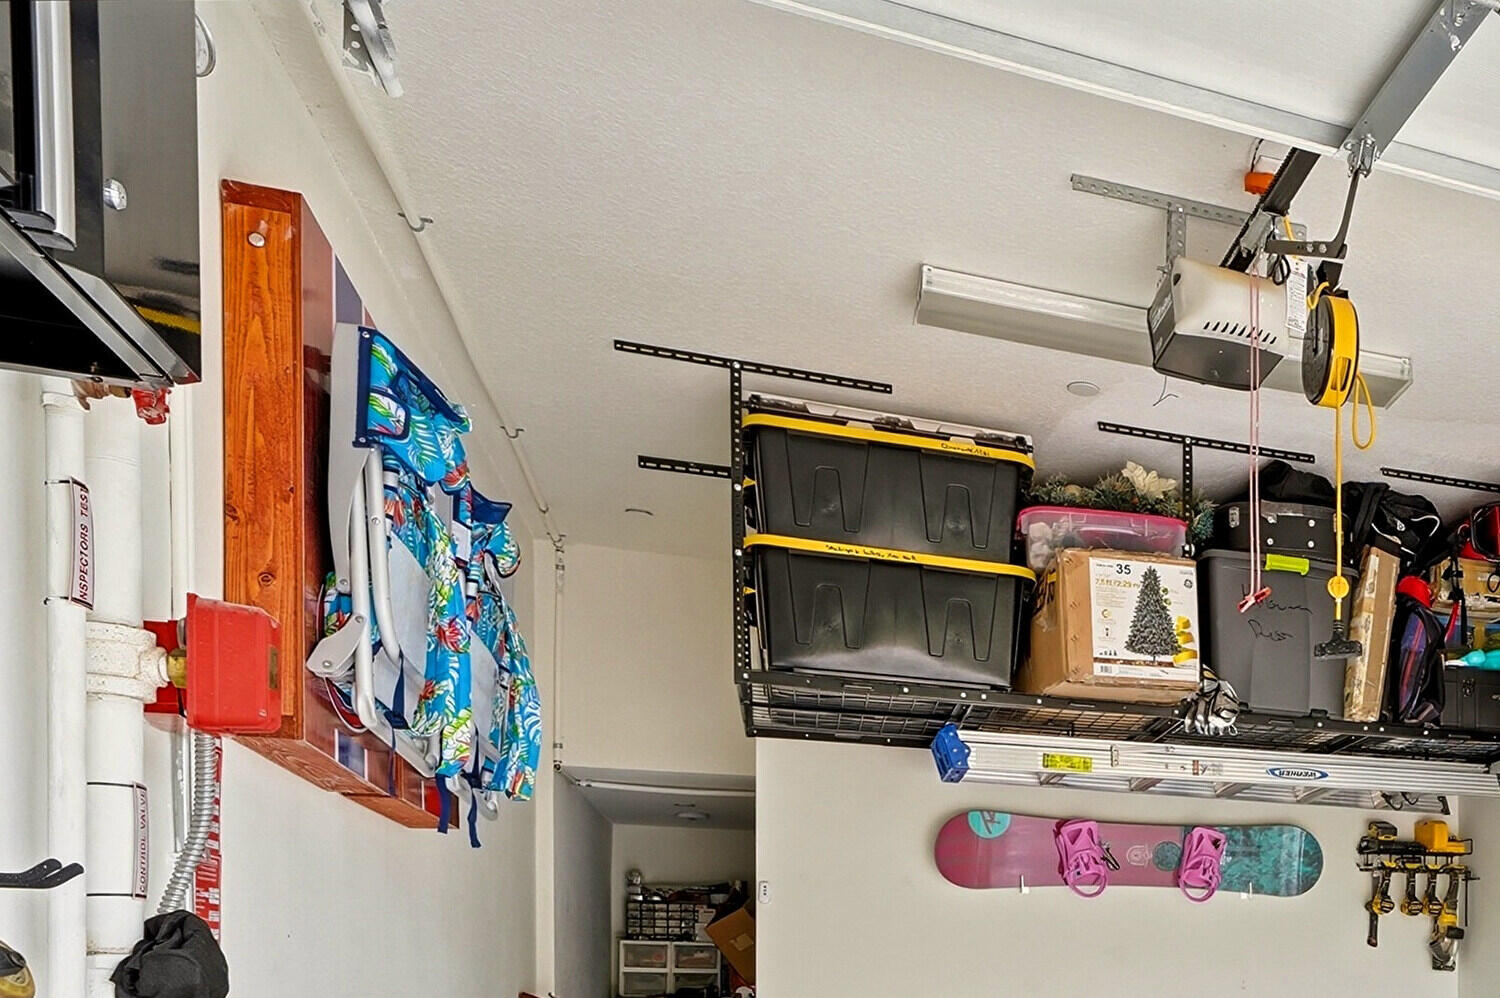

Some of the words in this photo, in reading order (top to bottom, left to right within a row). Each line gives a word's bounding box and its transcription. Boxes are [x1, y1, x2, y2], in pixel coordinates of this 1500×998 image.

[79, 523, 89, 601] NSPECTORS
[1116, 563, 1132, 576] 35
[1279, 770, 1317, 778] WERNER
